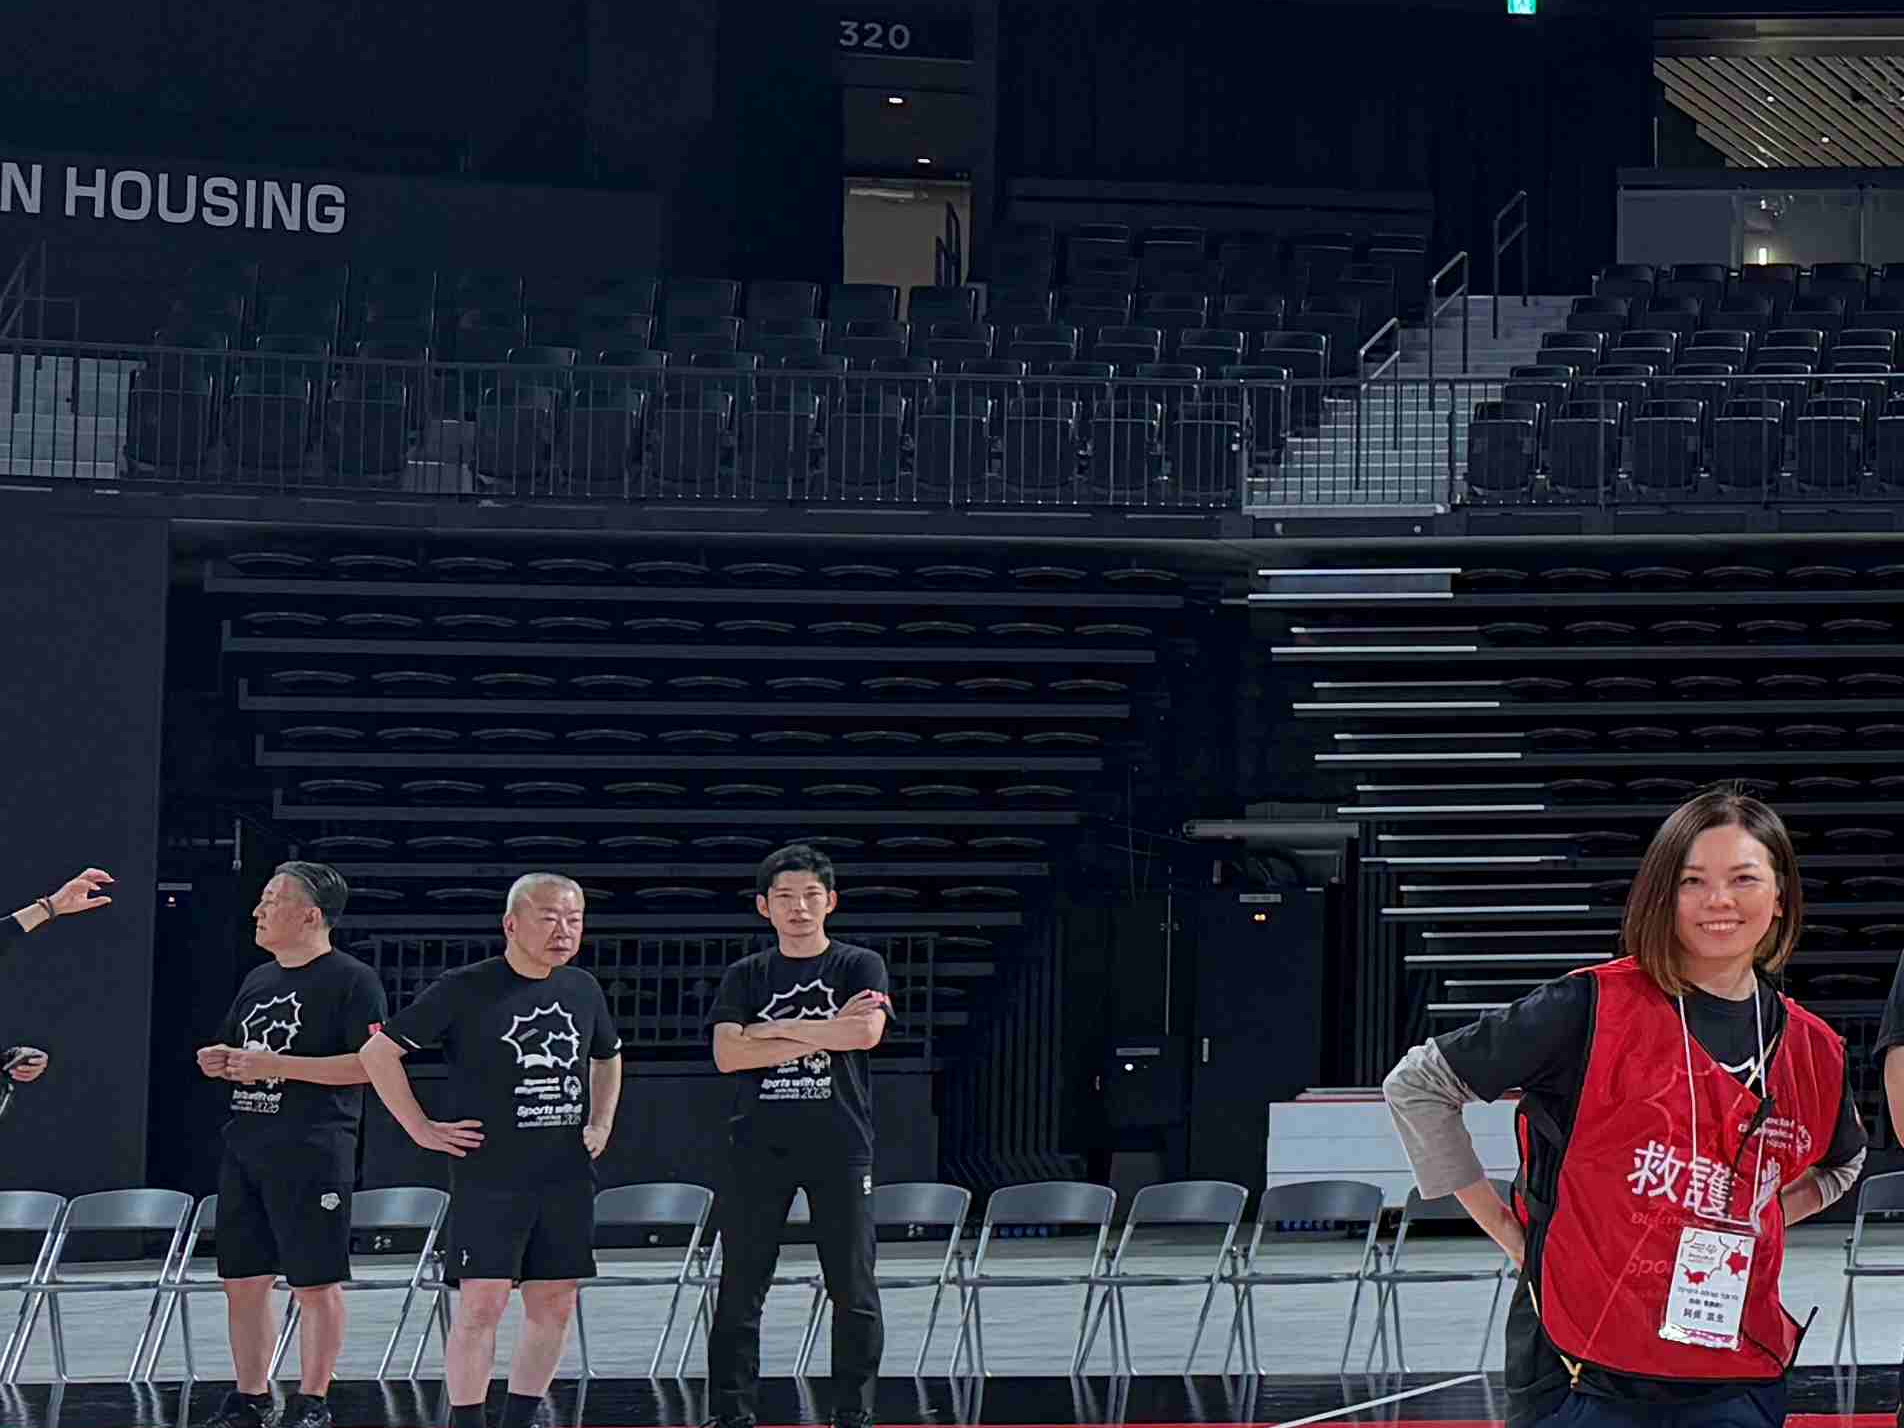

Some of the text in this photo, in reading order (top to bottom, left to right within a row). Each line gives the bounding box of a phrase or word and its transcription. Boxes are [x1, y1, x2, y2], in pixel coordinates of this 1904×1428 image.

[839, 21, 910, 50] 320
[65, 166, 346, 234] HOUSING
[1627, 1139, 1736, 1220] 救護
